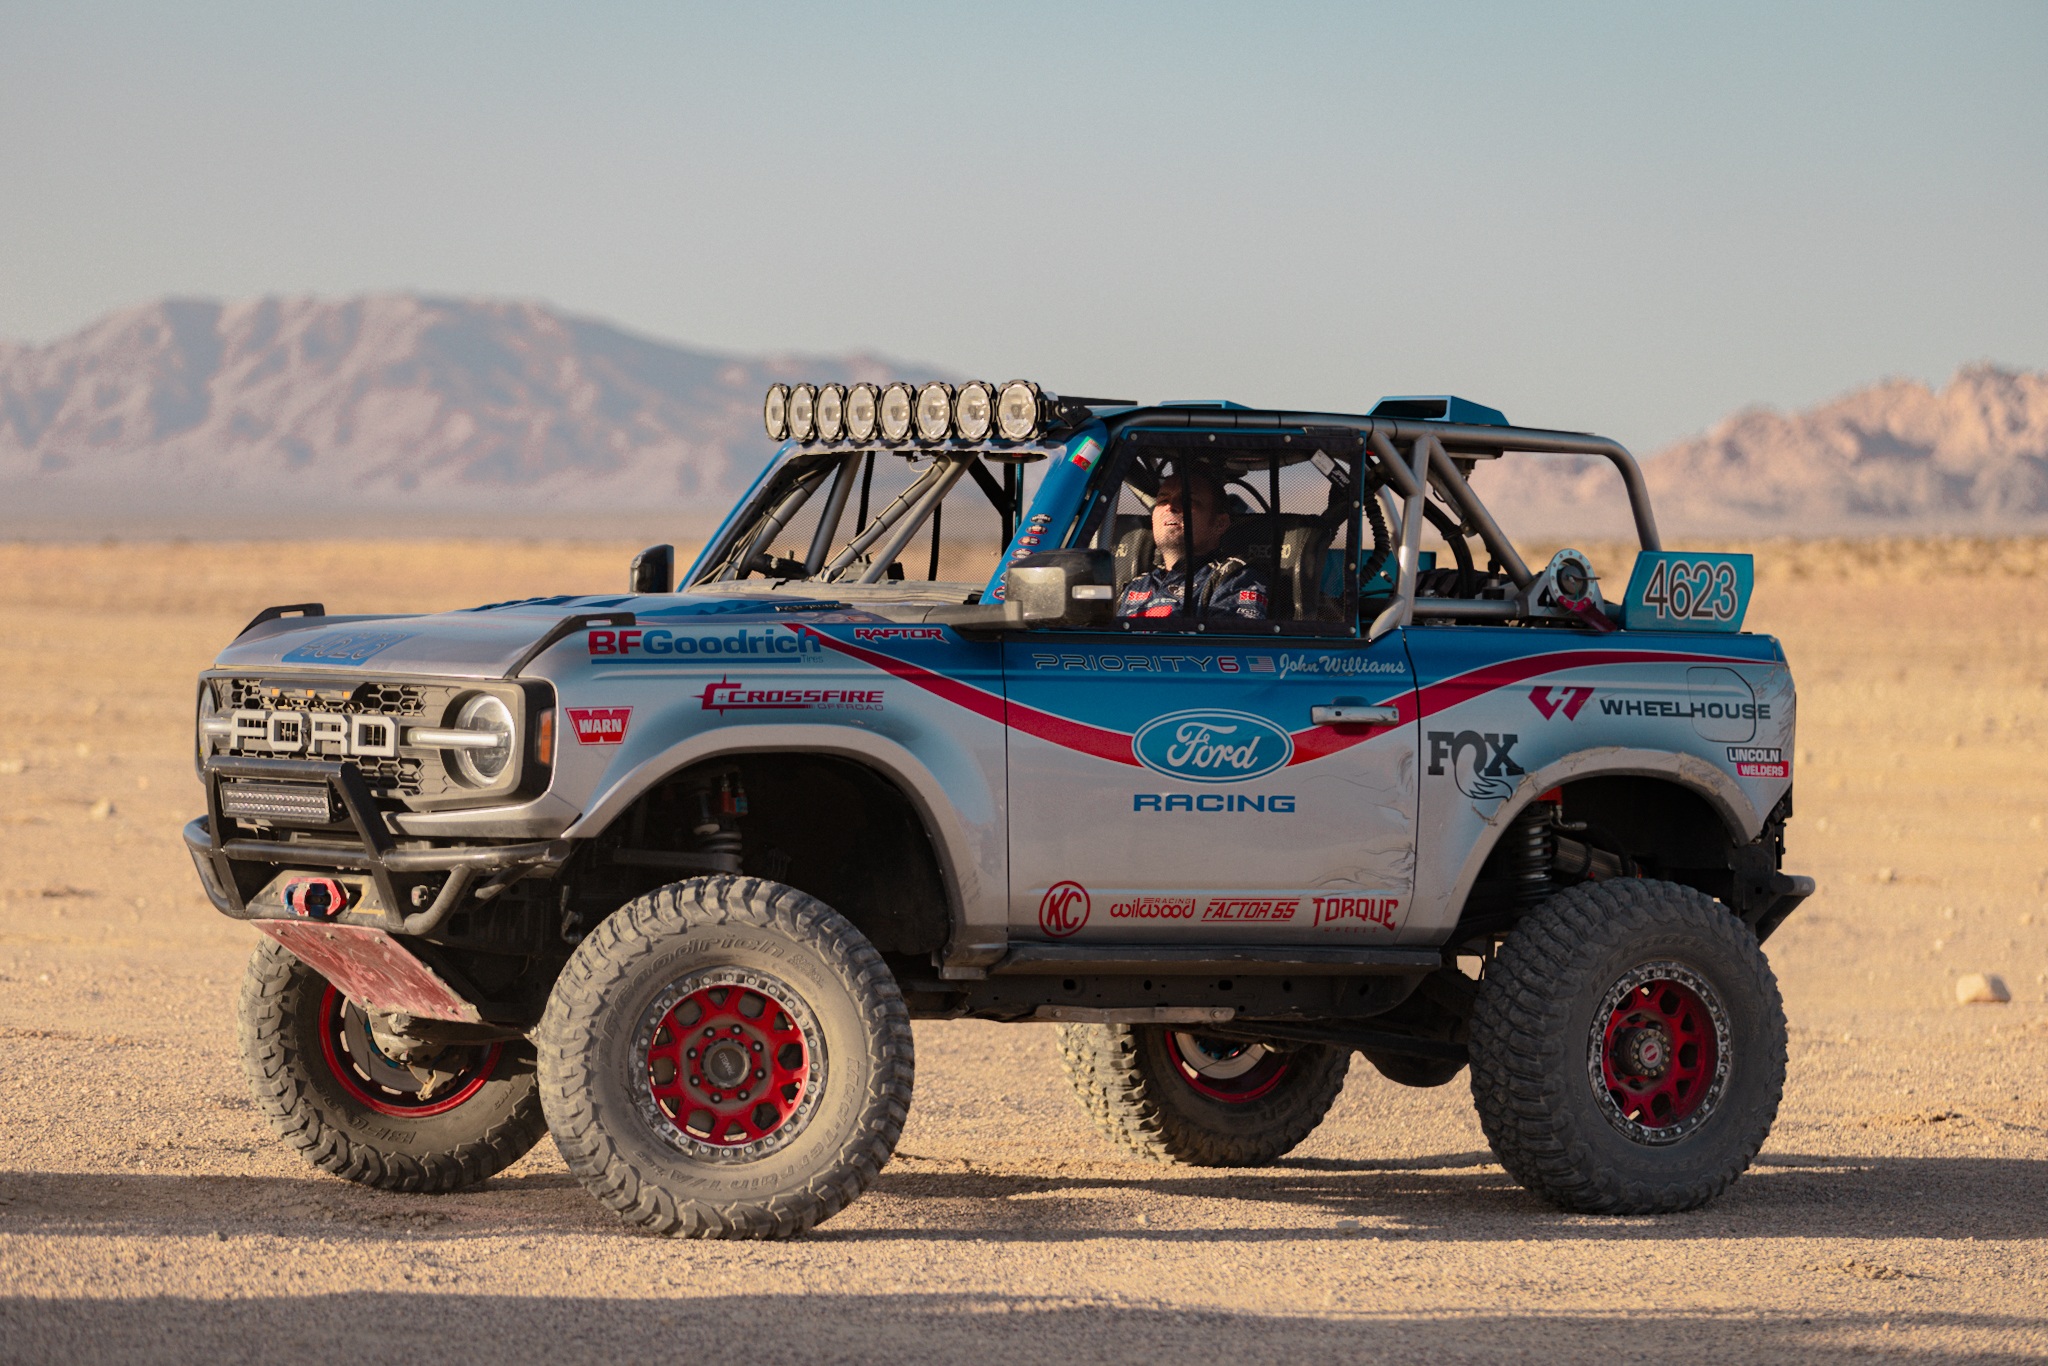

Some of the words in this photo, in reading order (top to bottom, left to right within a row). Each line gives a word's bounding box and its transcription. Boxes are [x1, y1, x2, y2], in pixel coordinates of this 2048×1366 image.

[1643, 559, 1738, 621] 4623
[588, 628, 823, 655] BFGoodrich
[854, 627, 950, 645] RAPTOR
[801, 654, 824, 664] Tires
[1280, 653, 1319, 679] John
[1319, 655, 1406, 674] Williams
[1600, 699, 1771, 720] WHEELHOUSE
[231, 710, 398, 757] FORD
[578, 717, 622, 734] WARN
[1166, 722, 1261, 769] Ford
[1427, 730, 1525, 776] FOX
[1728, 748, 1781, 763] LINCOLN
[1740, 765, 1784, 777] WELDERS
[1134, 794, 1295, 812] RACING
[1046, 887, 1083, 932] KC
[1110, 898, 1196, 918] wilwood
[1203, 902, 1272, 919] FACTOR
[1272, 902, 1299, 919] 55
[1312, 897, 1399, 931] TORQUE
